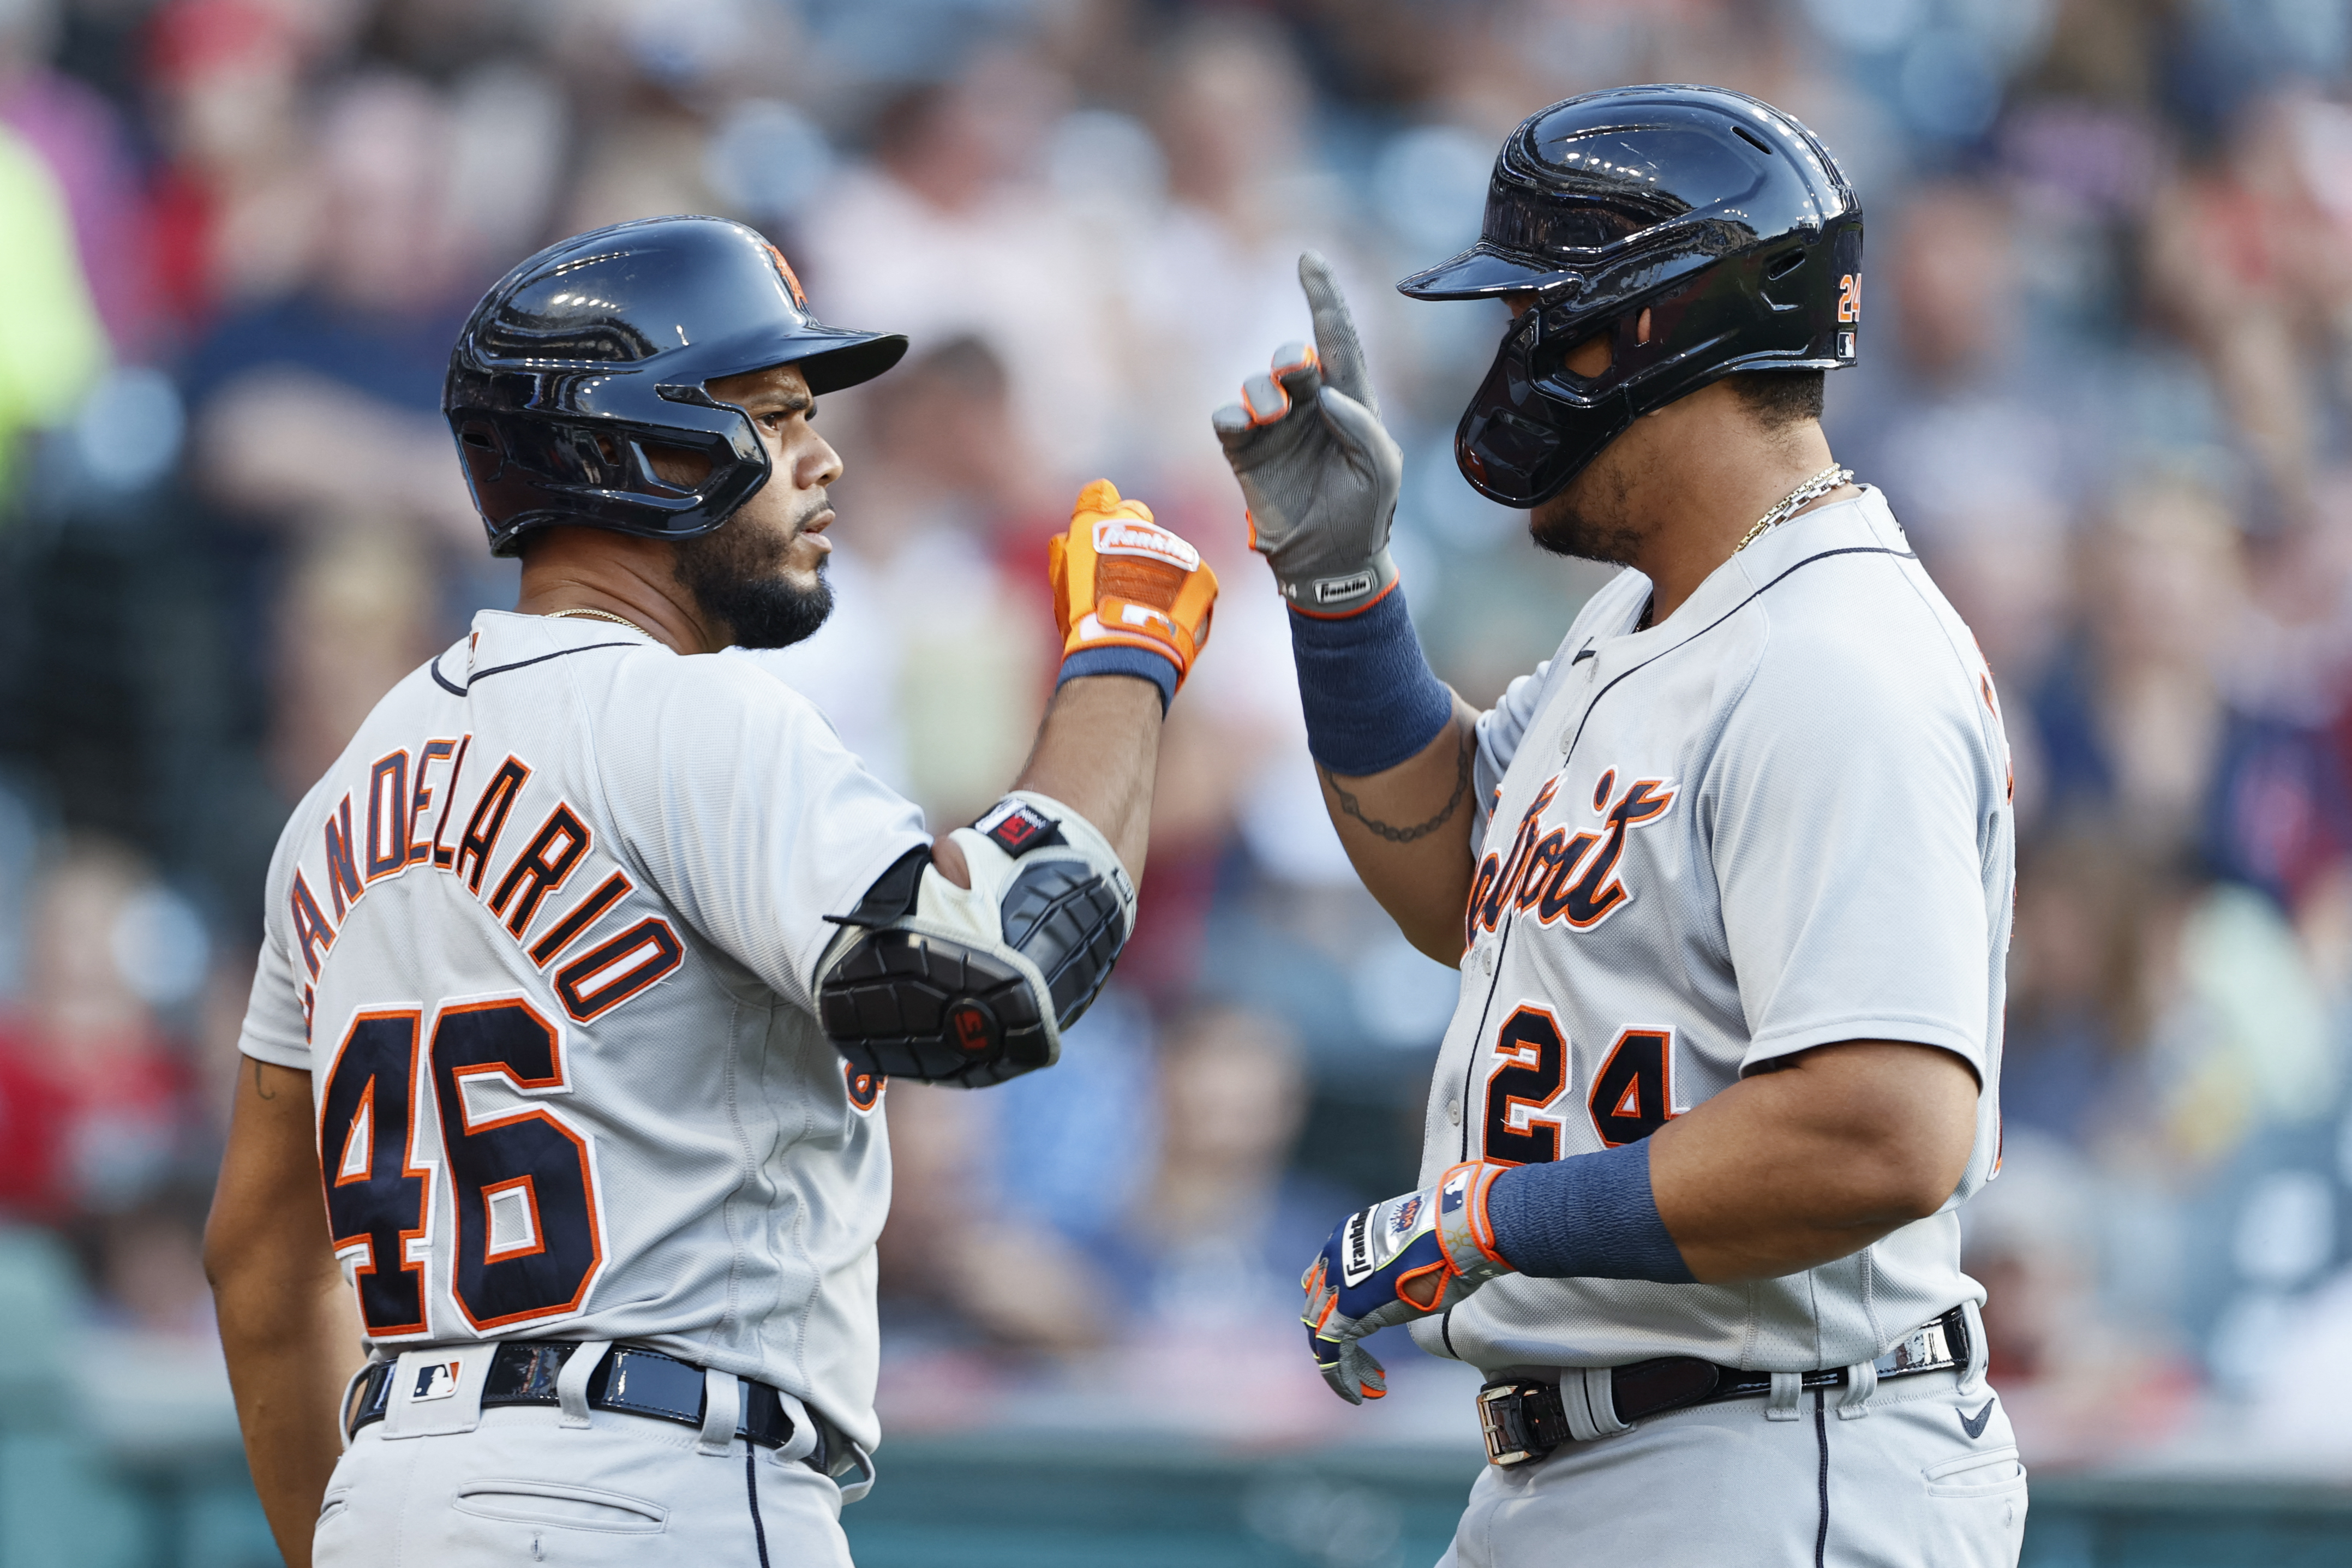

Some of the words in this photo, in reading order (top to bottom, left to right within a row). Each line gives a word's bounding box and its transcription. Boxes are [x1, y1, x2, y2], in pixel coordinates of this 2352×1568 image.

[1838, 273, 1862, 322] 24
[288, 731, 687, 1048] ANDELARIO
[1461, 765, 1682, 965] etroit
[316, 989, 612, 1339] 46
[1480, 998, 1691, 1169] 24
